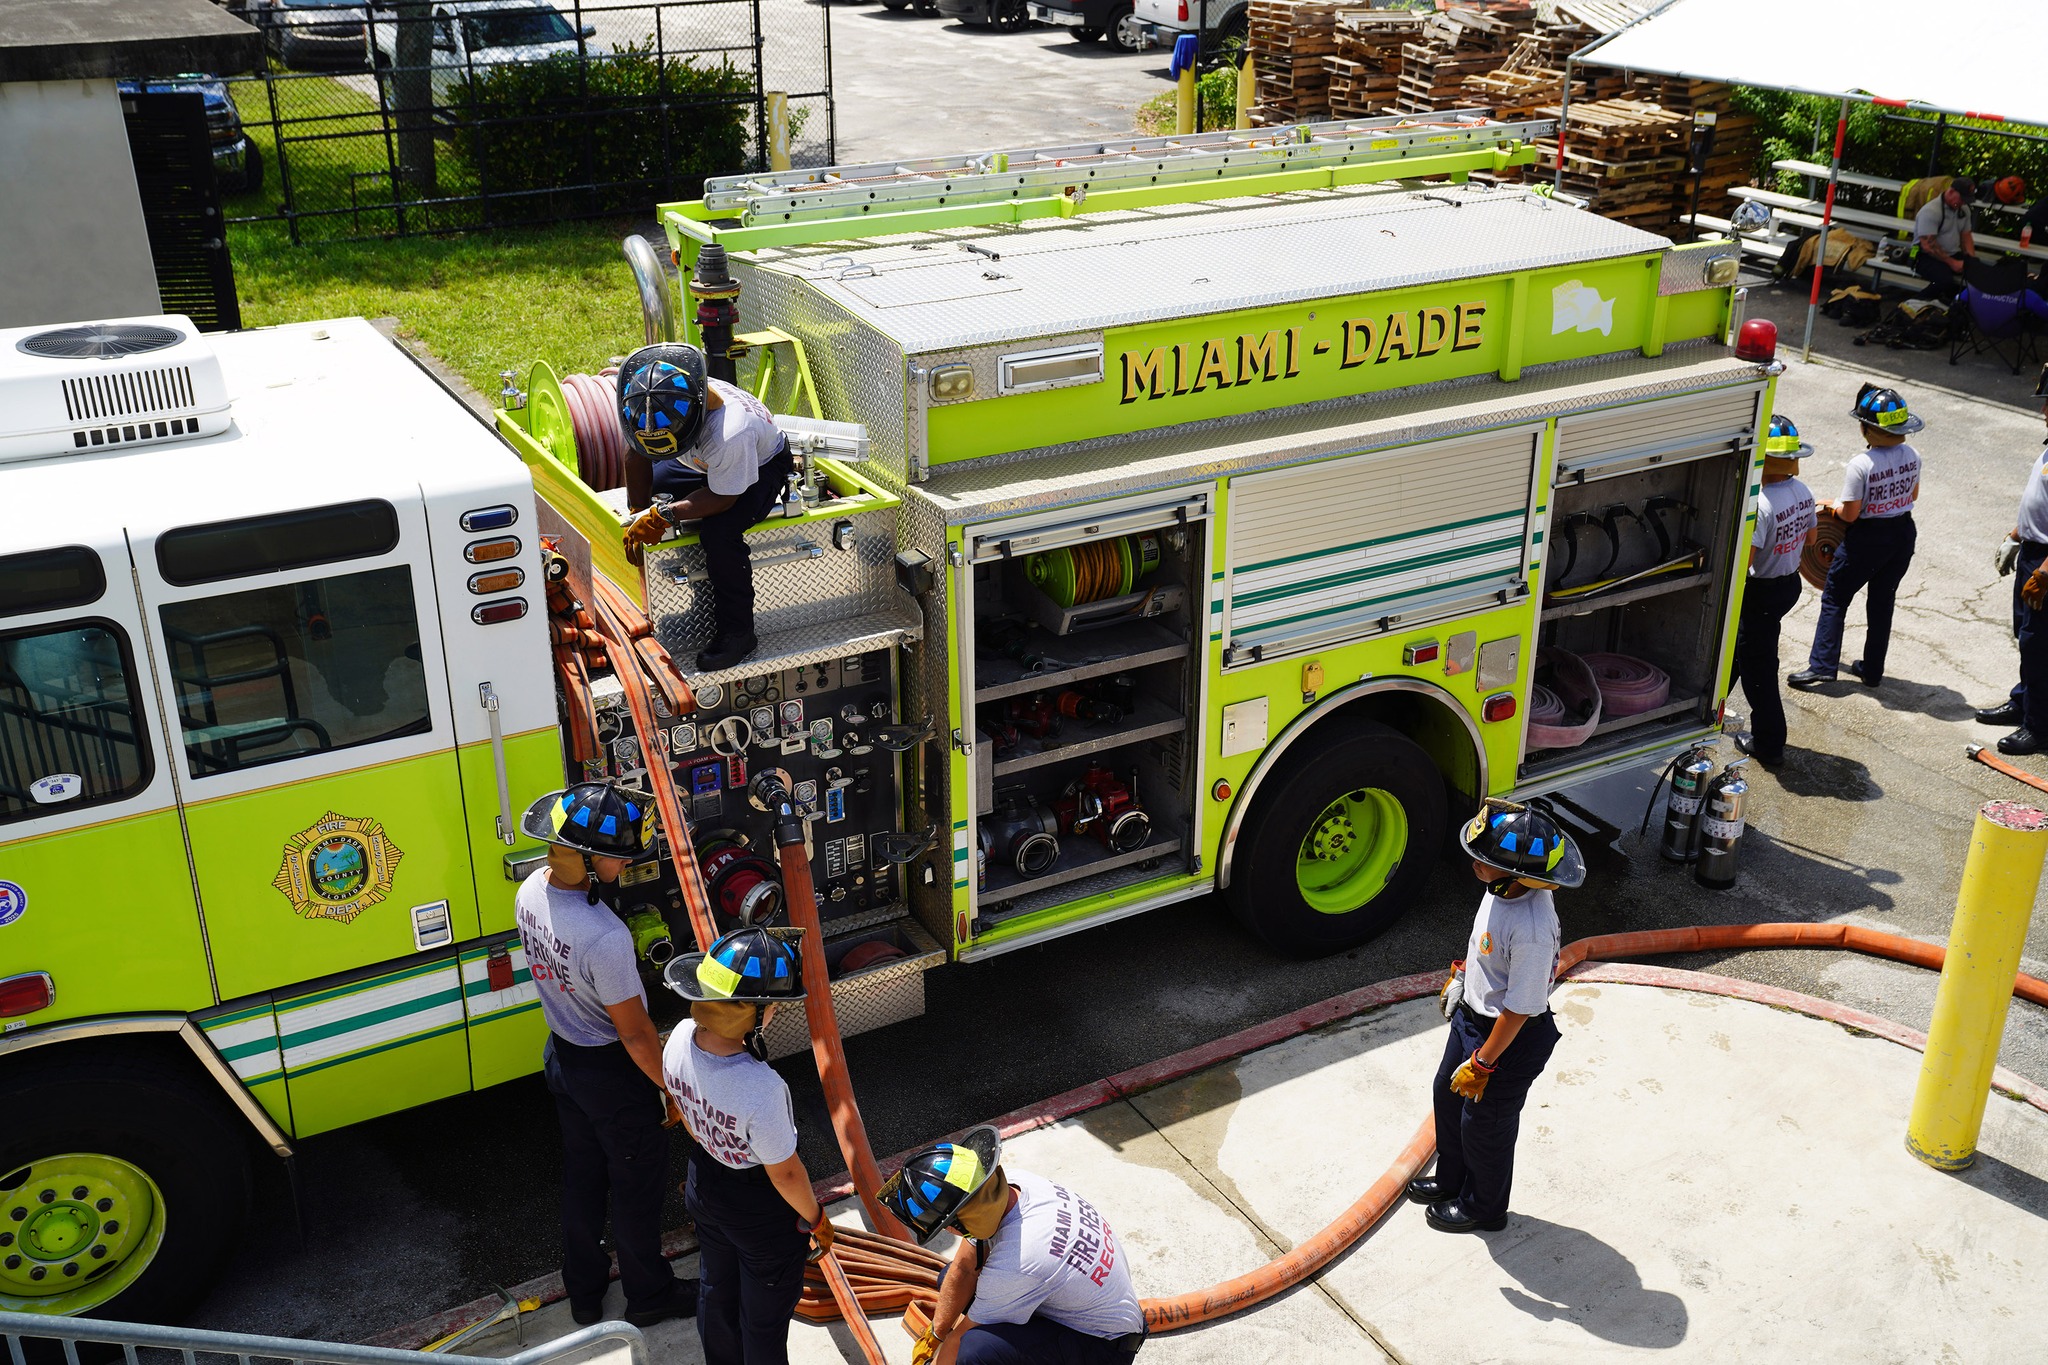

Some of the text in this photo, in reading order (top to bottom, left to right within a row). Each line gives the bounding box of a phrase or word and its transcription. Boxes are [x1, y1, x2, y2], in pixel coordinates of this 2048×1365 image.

[1869, 468, 1894, 483] MIAMI
[1869, 484, 1888, 502] FIRE
[317, 820, 347, 835] FIRE
[372, 836, 386, 883] RESCUE
[290, 855, 305, 900] SAFETY
[319, 869, 362, 884] COUNTY
[321, 883, 364, 900] FLORIDA
[1049, 1208, 1072, 1259] MIAMI
[1066, 1228, 1100, 1276] FIRE
[1090, 1217, 1115, 1287] RECR
[1143, 1302, 1190, 1326] ONN
